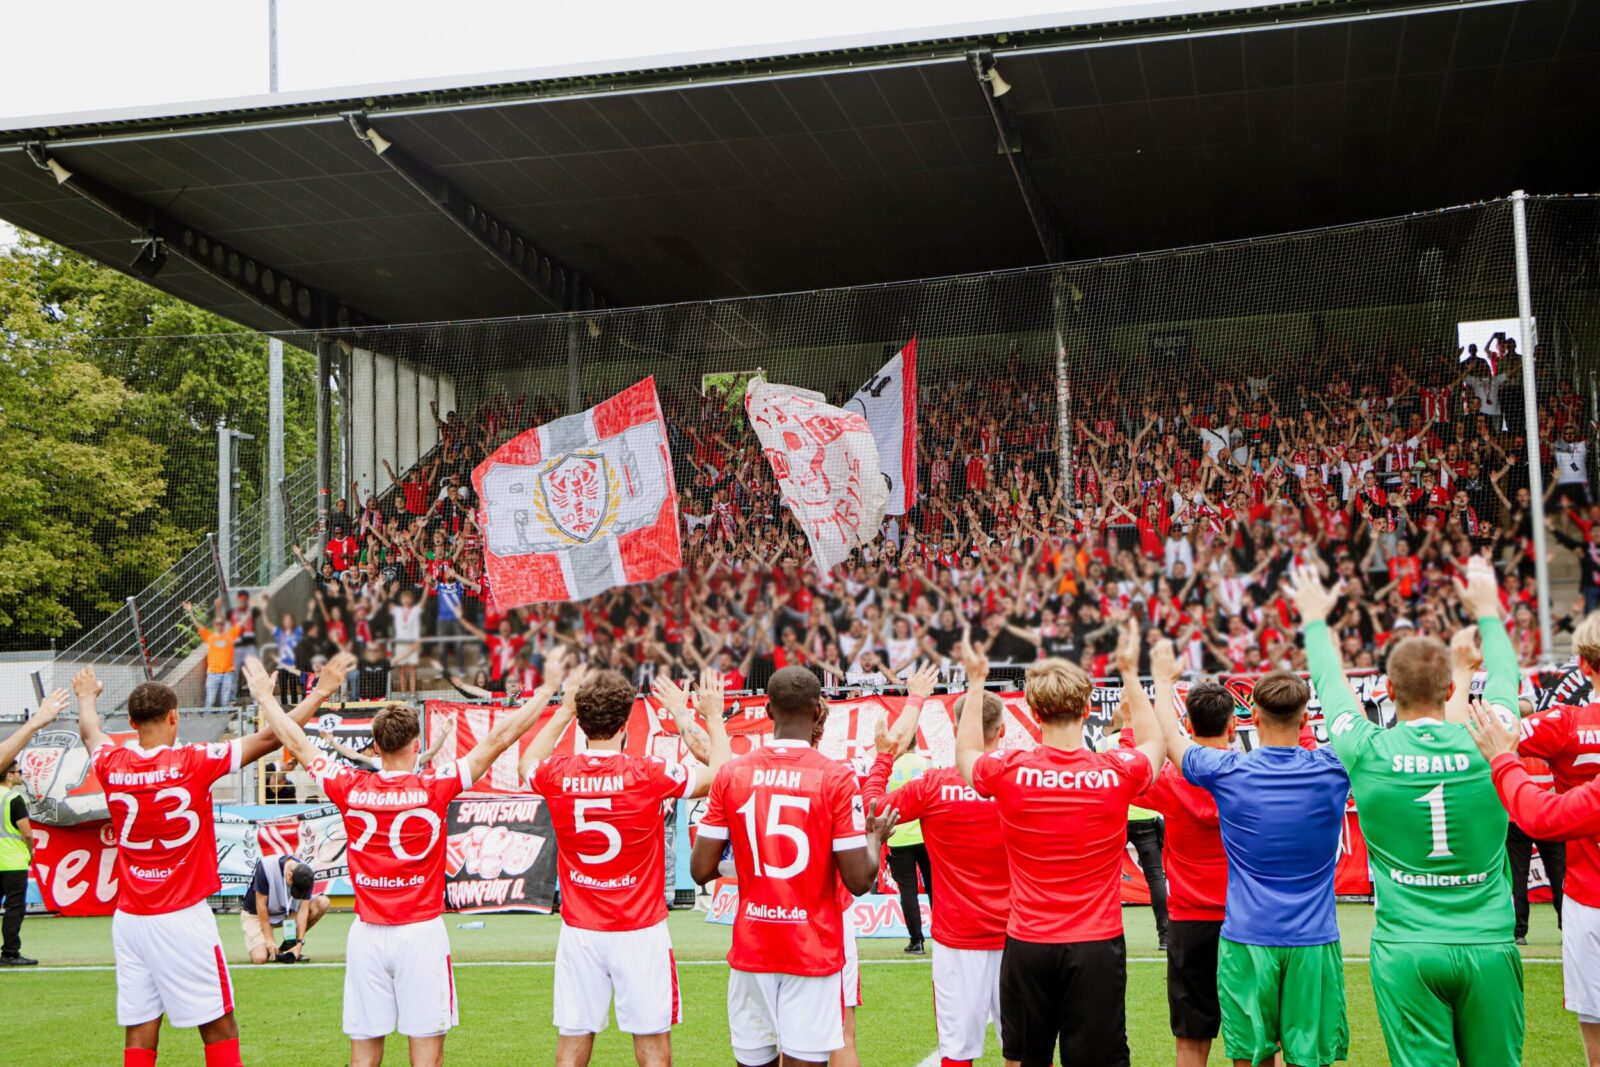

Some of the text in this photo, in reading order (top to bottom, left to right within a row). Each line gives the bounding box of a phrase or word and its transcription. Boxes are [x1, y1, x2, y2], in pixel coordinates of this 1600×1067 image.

[1392, 753, 1470, 773] SEBALD
[108, 768, 184, 785] AWORTWIE-G.
[562, 776, 624, 792] PELIVAN
[752, 769, 802, 788] DUAH
[1016, 766, 1119, 789] macron
[347, 790, 429, 806] BORGMANN
[109, 787, 200, 850] 23
[456, 800, 542, 825] SPORTSTADT
[1413, 781, 1454, 858] 1
[345, 808, 441, 861] 20
[574, 798, 622, 864] 5
[736, 790, 810, 879] 15
[356, 873, 425, 887] Koalick.de
[447, 879, 513, 908] FRANKFURT
